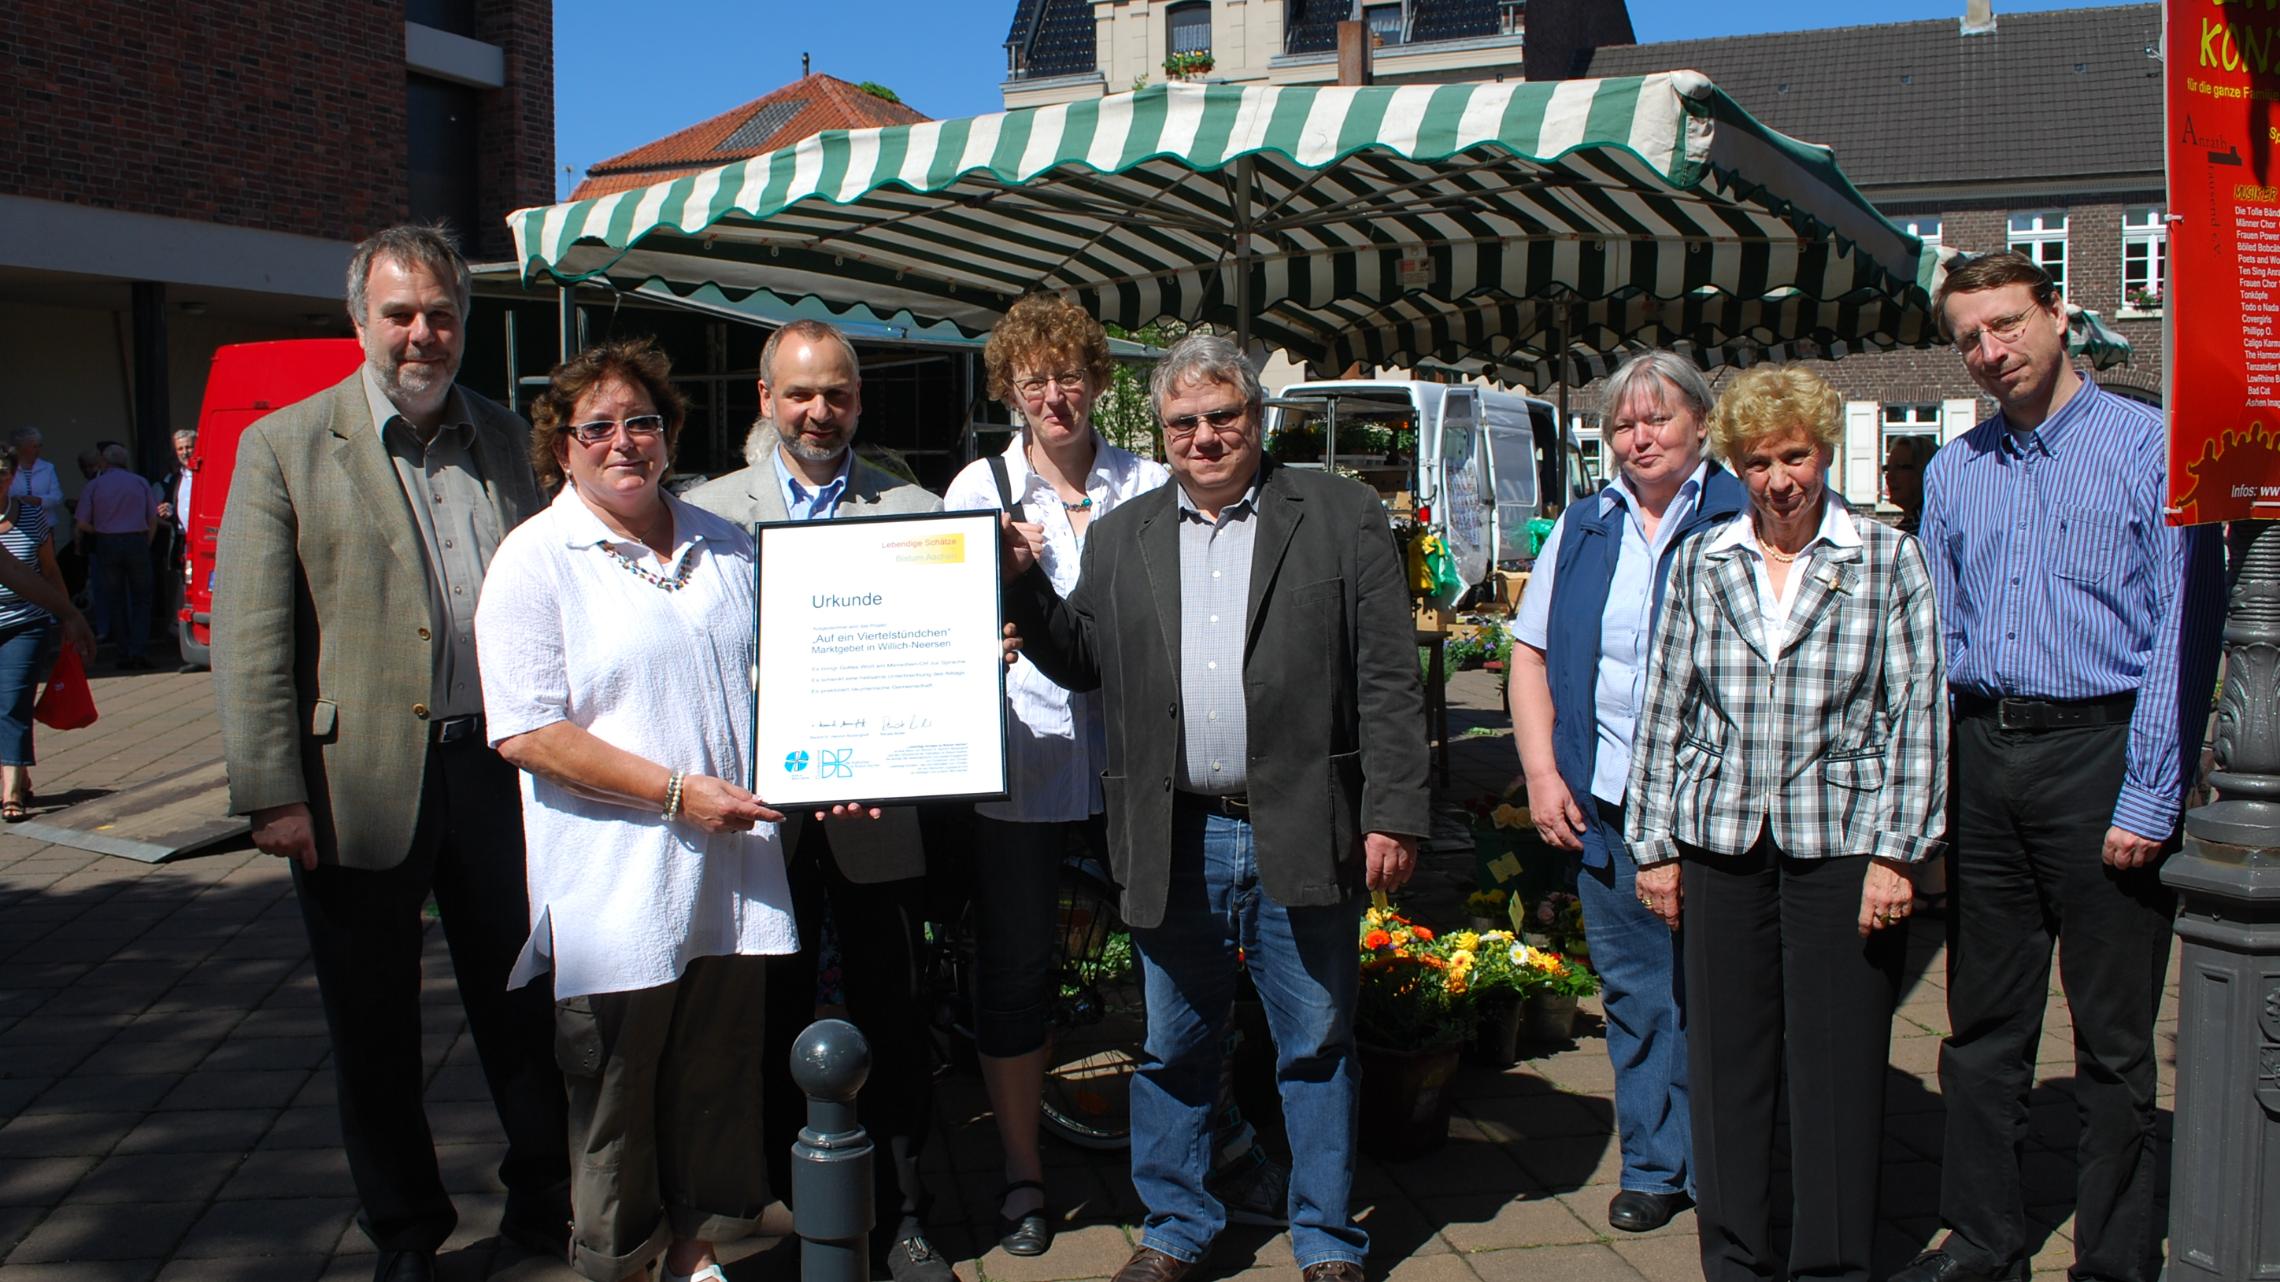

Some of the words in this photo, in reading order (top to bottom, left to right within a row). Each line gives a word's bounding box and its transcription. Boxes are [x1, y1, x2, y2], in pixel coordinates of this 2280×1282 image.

[2187, 76, 2198, 92] für
[2198, 80, 2212, 95] die
[2213, 85, 2241, 99] ganze
[2181, 112, 2229, 150] Anrath
[2233, 184, 2279, 203] MUSIKER
[2235, 206, 2246, 215] Die
[2247, 207, 2262, 216] Tolle
[2236, 218, 2260, 227] Männer
[2261, 220, 2276, 228] Chor
[2237, 230, 2258, 239] Frauen
[2260, 232, 2280, 240] Power
[2238, 254, 2256, 263] Poets
[2257, 256, 2268, 264] and
[2239, 266, 2250, 274] Ten
[2252, 267, 2266, 277] Sing
[2240, 278, 2260, 287] Frauen
[2262, 280, 2278, 288] Chor
[2241, 290, 2268, 301] Tonköpfe
[2242, 302, 2256, 311] Todo
[2263, 304, 2280, 312] Nada
[2242, 314, 2272, 325] Covergirls
[2266, 327, 2272, 335] O.
[2244, 338, 2262, 348] Caligo
[2245, 351, 2256, 359] The
[2248, 386, 2260, 395] Bad
[2246, 399, 2266, 408] Ashen
[2231, 483, 2258, 498] Infos:
[881, 539, 923, 550] Lebendige
[924, 537, 957, 547] Schätze
[812, 592, 883, 609] Urkunde
[837, 632, 854, 643] ein
[811, 645, 864, 655] Marktgebet
[867, 643, 875, 652] in
[877, 639, 952, 651] Willich-Neersen
